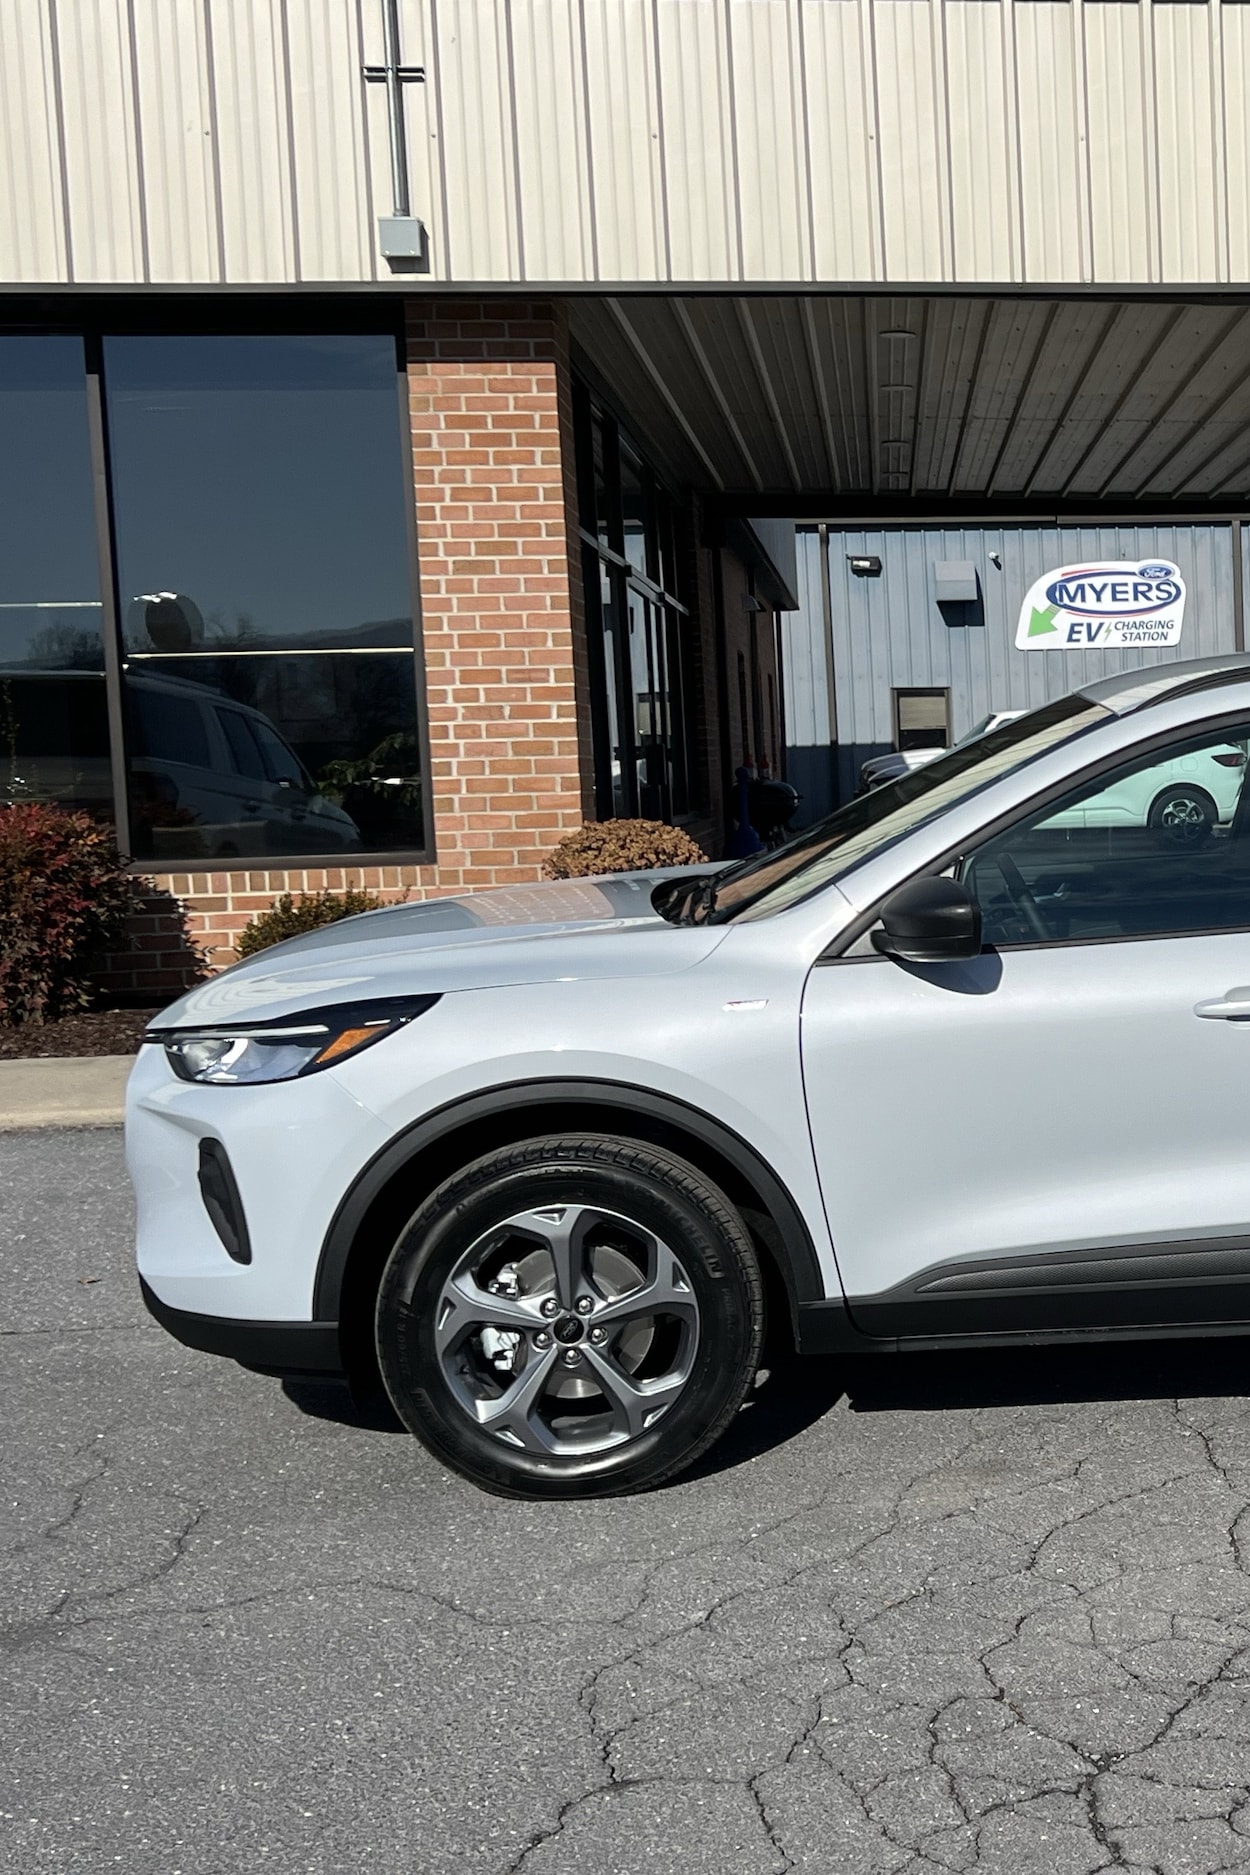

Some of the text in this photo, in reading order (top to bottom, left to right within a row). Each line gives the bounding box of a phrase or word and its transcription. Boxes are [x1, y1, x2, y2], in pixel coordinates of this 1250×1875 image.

[1057, 582, 1173, 603] MYERS
[1066, 622, 1105, 643] EV
[1114, 620, 1175, 631] CHARGING
[1121, 631, 1169, 642] STATION
